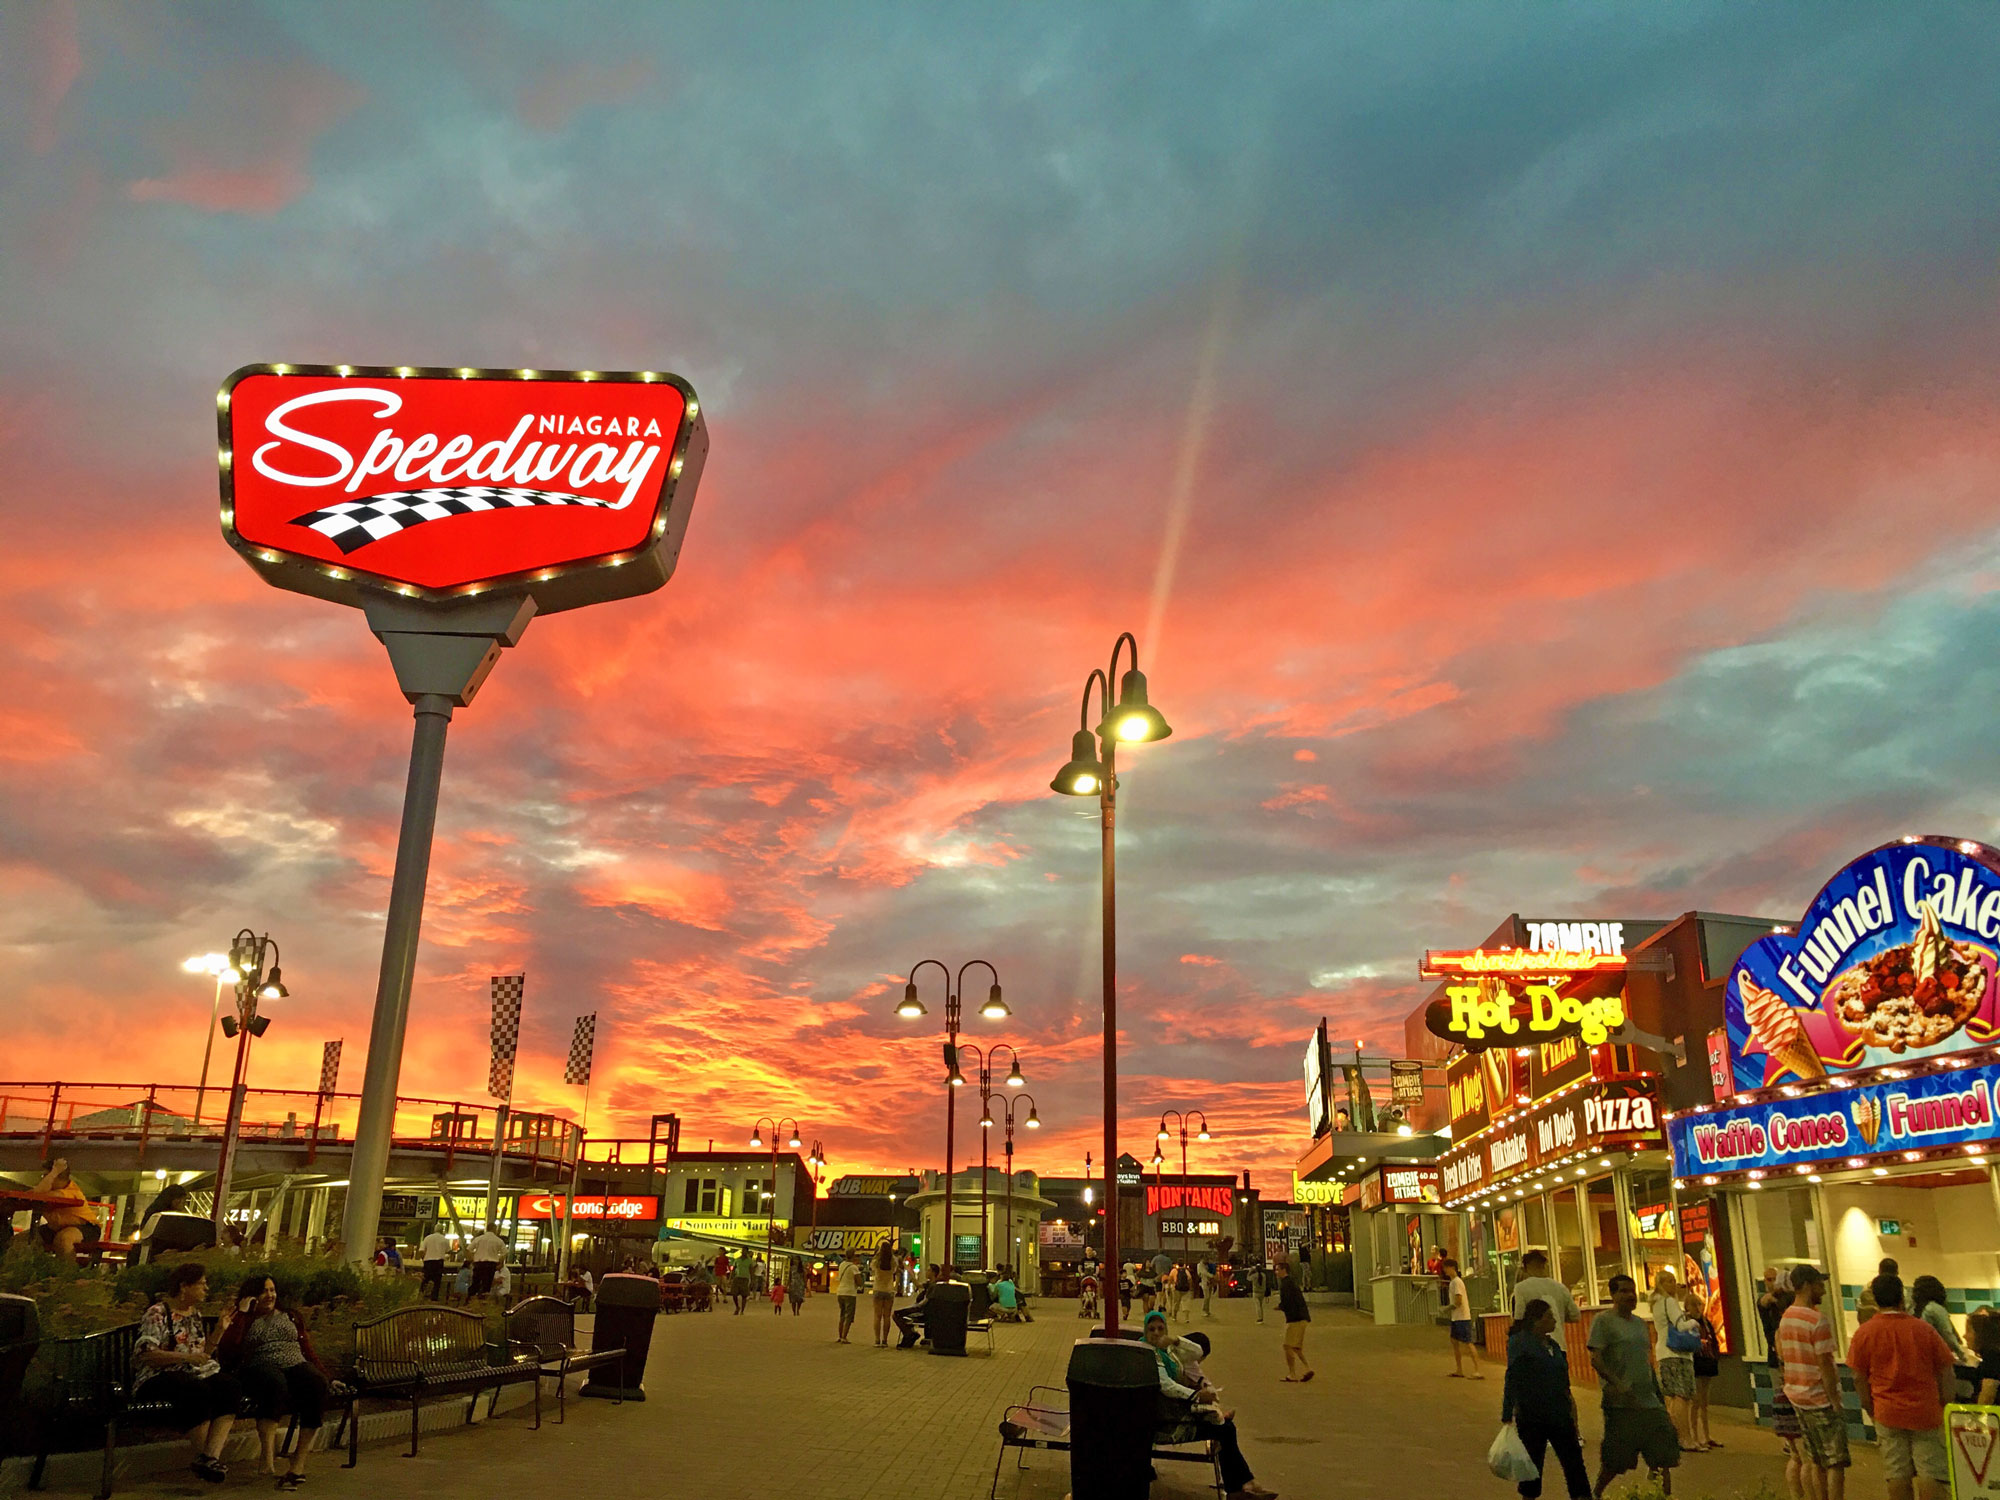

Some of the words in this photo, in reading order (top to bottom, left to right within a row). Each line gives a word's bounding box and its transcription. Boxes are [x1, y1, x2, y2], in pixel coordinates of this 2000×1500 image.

[539, 414, 662, 438] NIAGARA
[252, 387, 660, 510] Speedway
[1527, 922, 1625, 957] ZOMBIE
[1778, 866, 1894, 1007] Funnel
[1446, 986, 1520, 1039] Hot
[1525, 985, 1625, 1045] Dogs
[1392, 1074, 1421, 1088] ZOMBIE
[1399, 1086, 1423, 1098] ATTACK
[1449, 1080, 1464, 1120] Hot
[1463, 1066, 1484, 1112] Dogs
[1583, 1095, 1656, 1136] Pizza
[1695, 1119, 1766, 1162] Waffle
[1770, 1114, 1847, 1151] Cones
[1888, 1082, 1991, 1136] Funnel
[1538, 1116, 1554, 1154] Hot
[1552, 1106, 1577, 1148] Dogs
[1490, 1132, 1528, 1174] Milkshakes
[829, 1178, 899, 1195] SUBWAY
[1386, 1170, 1420, 1188] ZOMBIE
[1443, 1161, 1459, 1193] Fresh
[1458, 1156, 1468, 1187] Cut
[1466, 1152, 1483, 1184] Fries
[1146, 1185, 1233, 1217] MONTANA'S
[1394, 1185, 1422, 1199] ATTACK
[571, 1202, 604, 1215] cono
[685, 1220, 739, 1230] Souvenir
[742, 1220, 770, 1231] Mart
[802, 1229, 891, 1250] SUBWAY
[1162, 1222, 1184, 1234] BBQ
[1186, 1222, 1196, 1235] &
[1198, 1222, 1219, 1235] BAR
[1965, 1434, 1987, 1448] YIELD
